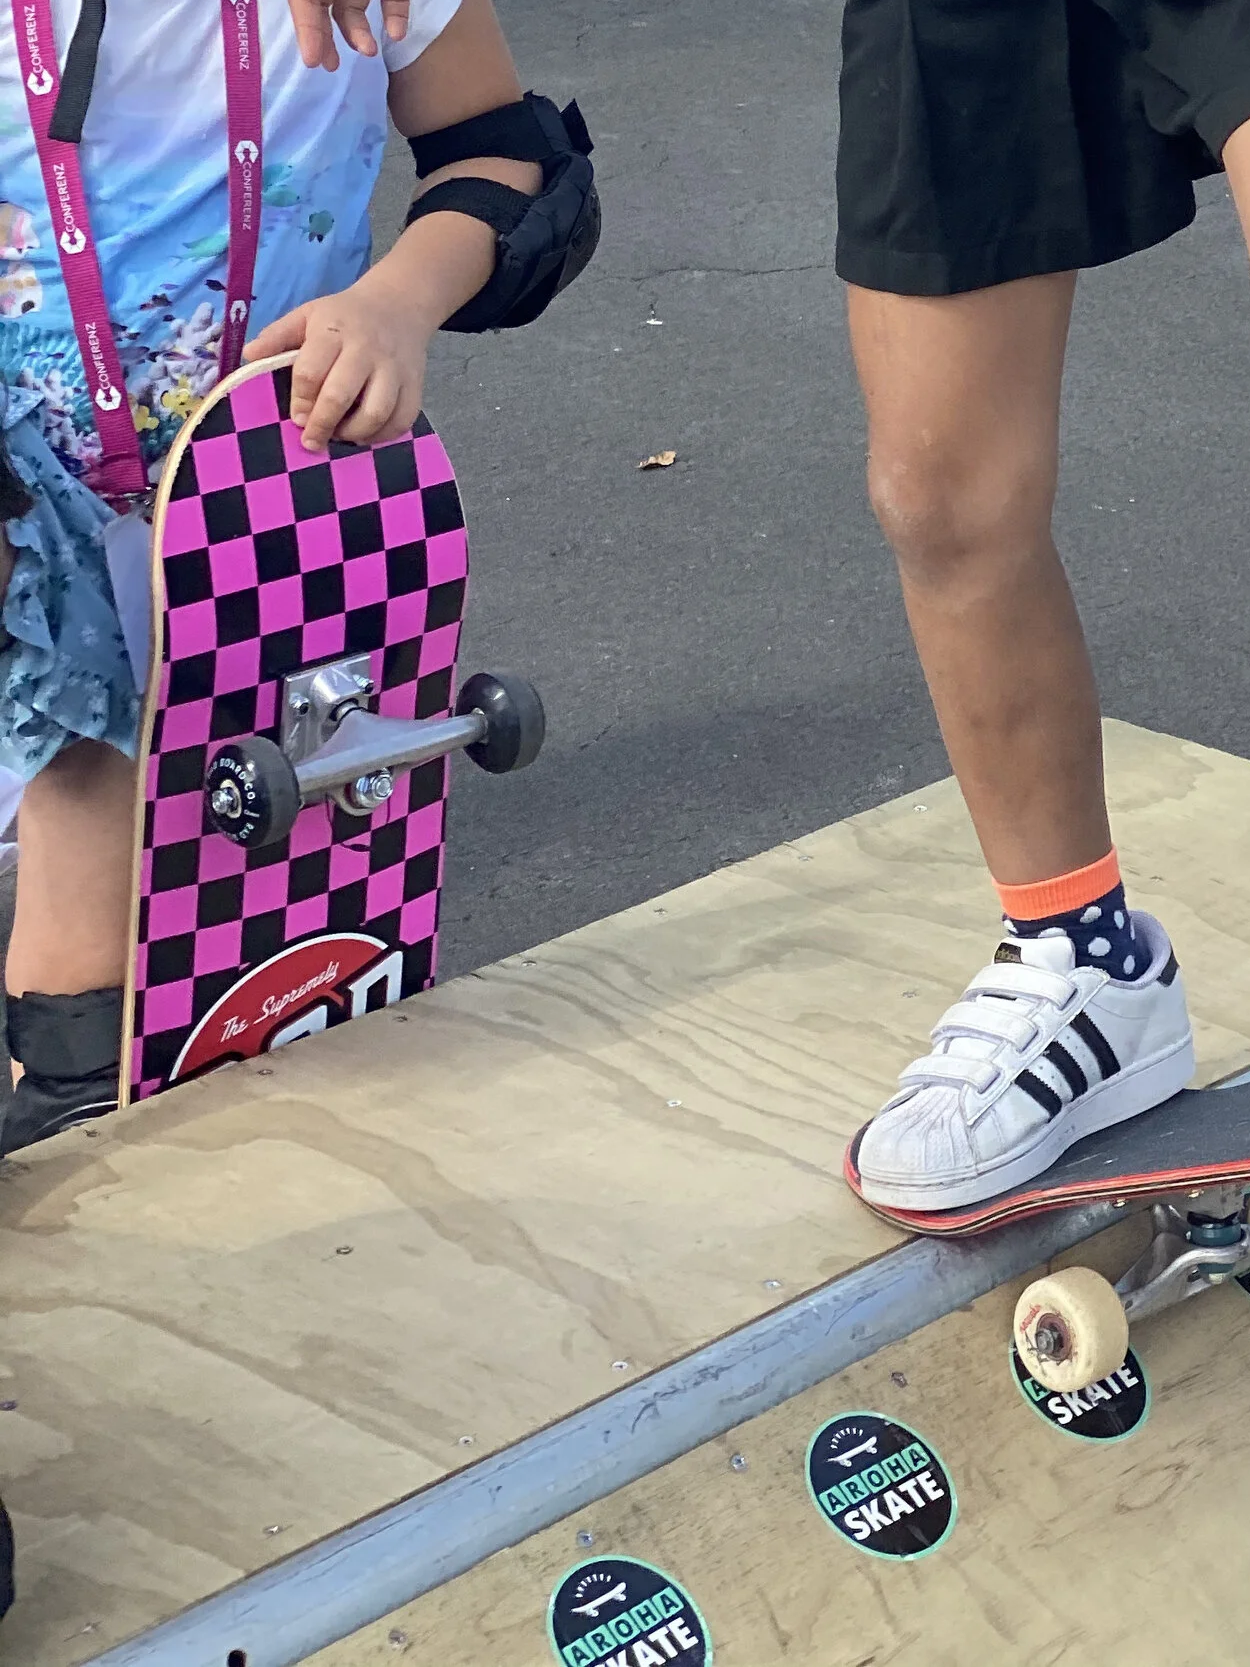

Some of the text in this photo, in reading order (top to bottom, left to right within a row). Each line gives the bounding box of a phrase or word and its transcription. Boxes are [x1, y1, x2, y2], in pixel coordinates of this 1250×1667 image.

[23, 4, 43, 74] CONFERENZ
[234, 2, 249, 71] CONFERENZ
[52, 162, 77, 233] CONFERENZ
[242, 161, 252, 231] CONFERENZ
[85, 321, 112, 390] CONFERENZ
[220, 1011, 249, 1043] The
[253, 960, 339, 1025] Supremely
[826, 1447, 927, 1512] AROHA
[844, 1470, 945, 1541] SKATE
[571, 1592, 680, 1667] AROHA
